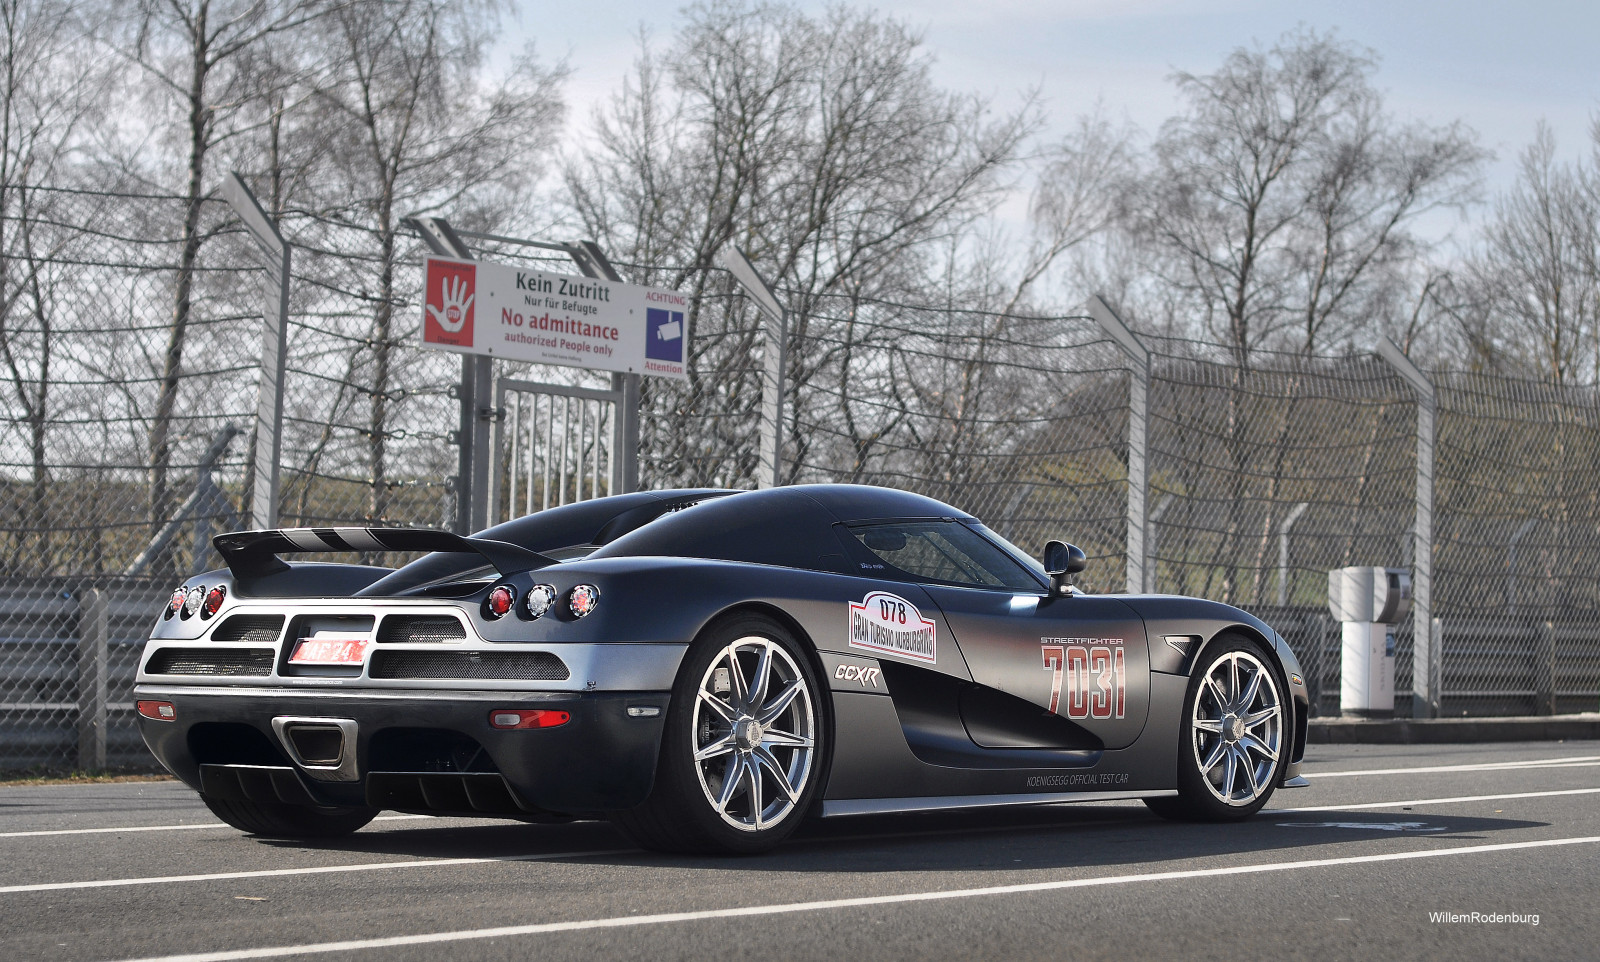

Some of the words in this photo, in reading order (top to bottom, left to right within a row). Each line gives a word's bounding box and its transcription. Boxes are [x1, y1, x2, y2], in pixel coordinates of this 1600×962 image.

[516, 271, 552, 293] Kein
[558, 278, 610, 302] Zutritt
[645, 291, 686, 306] ACHTUNG
[447, 308, 460, 319] STOP
[524, 295, 542, 307] Nur
[545, 297, 560, 309] für
[562, 300, 598, 316] Befugte
[501, 307, 524, 327] No
[529, 312, 619, 341] admittance
[504, 332, 557, 348] authorized
[560, 339, 591, 353] People
[593, 344, 613, 358] only
[645, 360, 683, 374] Attention
[880, 598, 907, 625] 078
[853, 611, 869, 642] GRAN
[870, 621, 894, 647] TURISMO
[1040, 636, 1124, 645] STREETFIGHTER
[834, 664, 880, 689] CCXR
[1041, 645, 1126, 720] 7031
[1026, 775, 1069, 787] KOENIGSEGG
[1069, 774, 1098, 785] OFFICIAL
[1099, 773, 1115, 784] TEST
[1114, 773, 1129, 784] CAR
